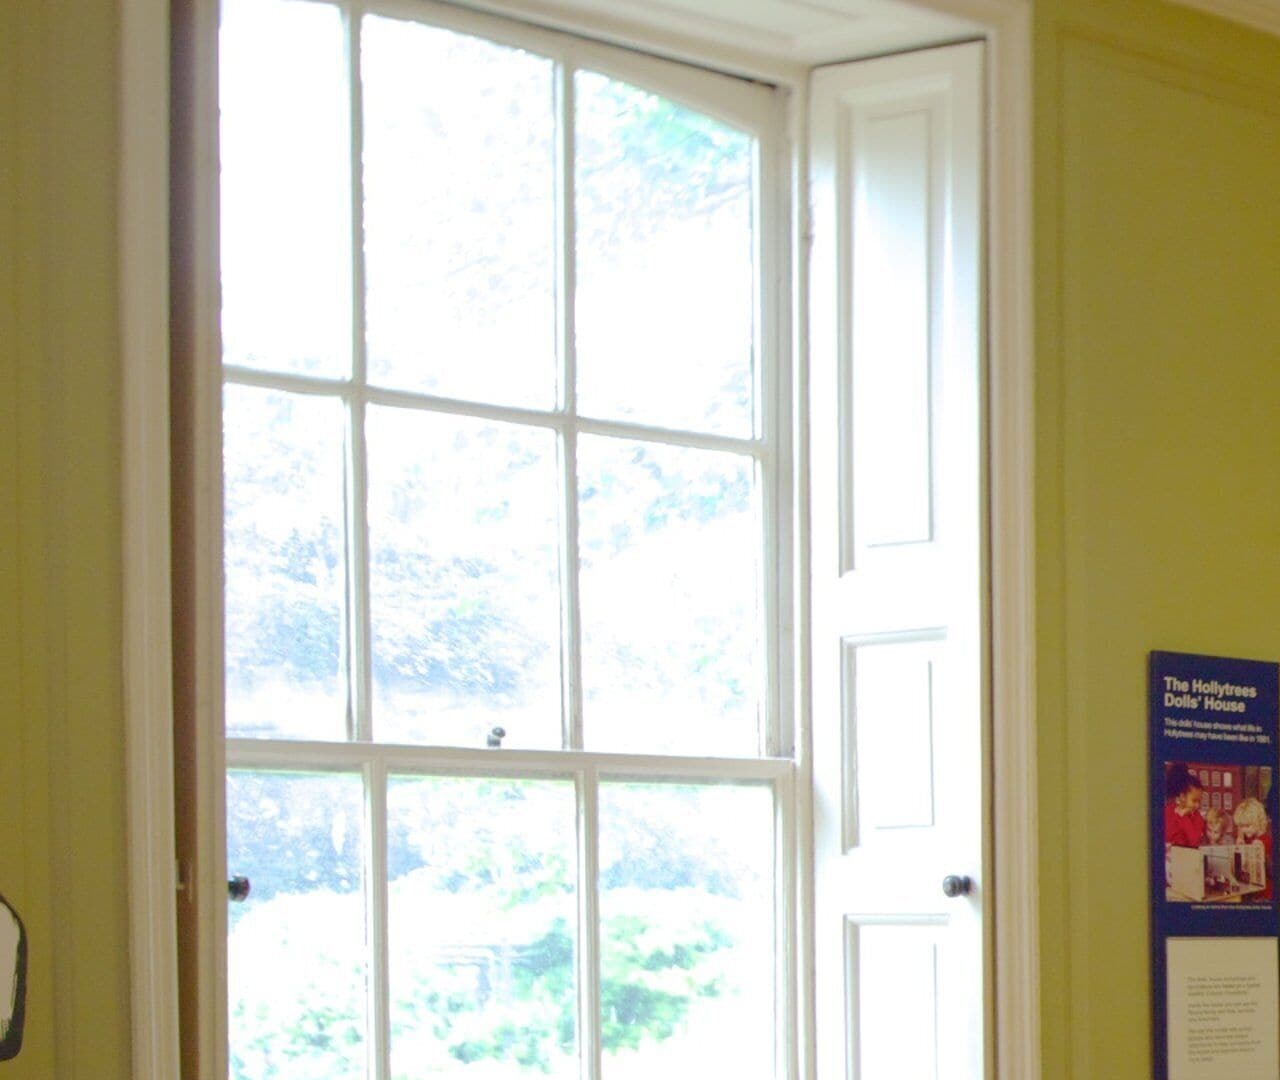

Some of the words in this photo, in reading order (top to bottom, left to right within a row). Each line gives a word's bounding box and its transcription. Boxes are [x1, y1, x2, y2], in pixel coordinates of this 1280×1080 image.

[1164, 676, 1189, 692] The
[1192, 679, 1257, 698] Hollytrees
[1164, 692, 1202, 709] Dolls'
[1204, 695, 1246, 712] House
